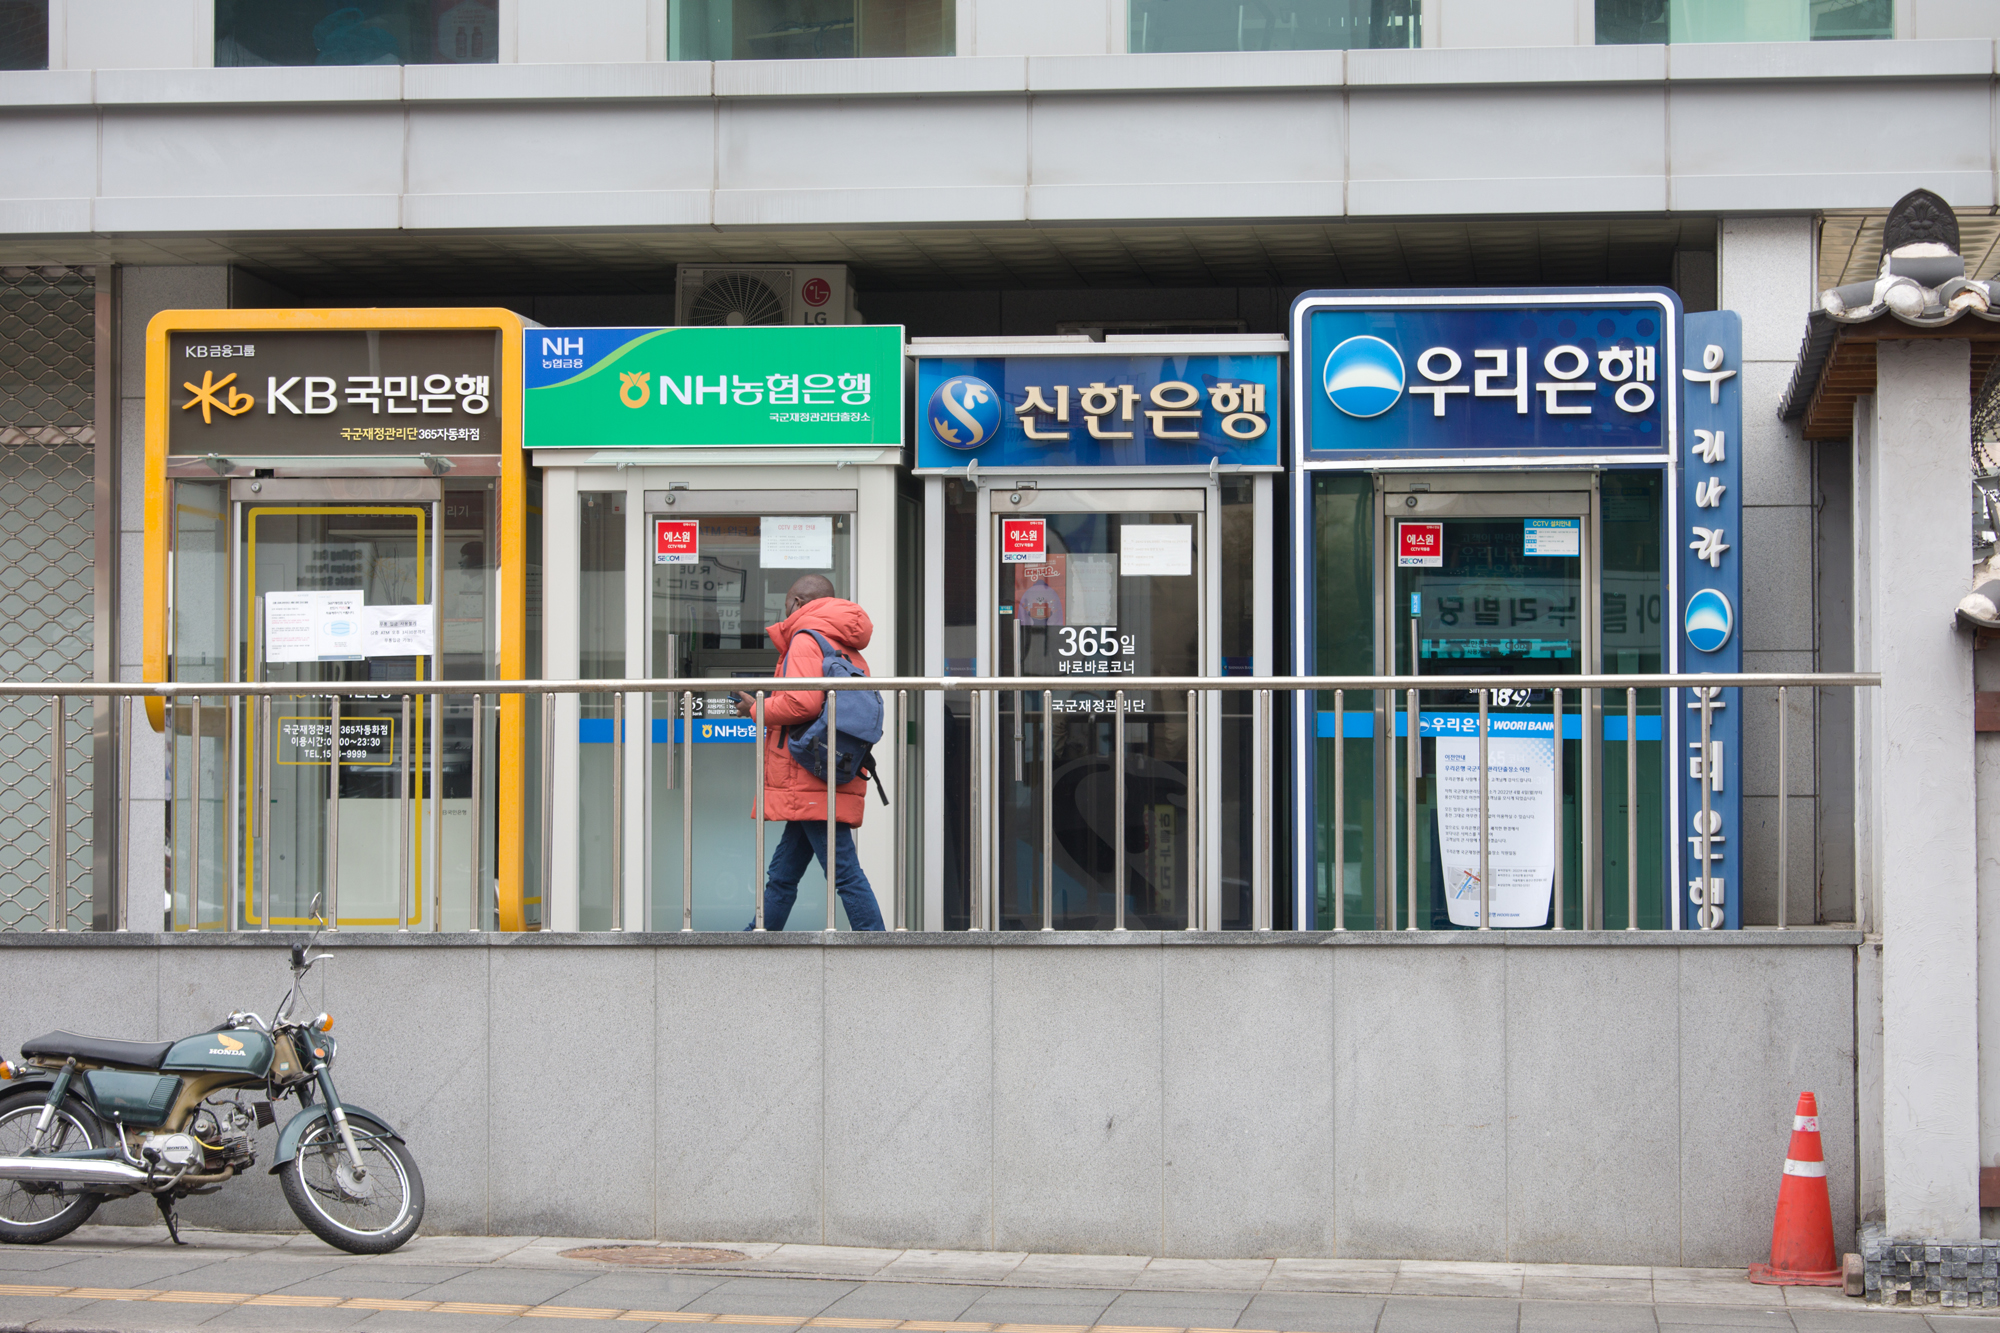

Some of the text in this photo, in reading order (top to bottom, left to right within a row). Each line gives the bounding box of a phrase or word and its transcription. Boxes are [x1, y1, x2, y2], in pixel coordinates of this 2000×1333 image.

[804, 311, 827, 326] LG
[542, 336, 583, 356] NH
[542, 358, 584, 369] 농협금융
[1408, 345, 1656, 417] 우리은행
[267, 373, 490, 415] KB국민은행
[659, 373, 872, 405] NH농협은행
[769, 411, 871, 423] 국군재정관리단출장소
[1014, 380, 1268, 441] 신한은행
[663, 531, 691, 543] 에스원
[1010, 530, 1038, 541] 에스원
[1406, 533, 1434, 546] 에스원
[1400, 557, 1424, 565] SECOM
[1058, 627, 1135, 657] 365일
[1058, 660, 1135, 674] 바로바로코너
[714, 725, 767, 738] NH농협
[1494, 721, 1527, 730] WOORI
[1467, 765, 1519, 773] 국군관리단출장소
[209, 1048, 246, 1056] HONDA
